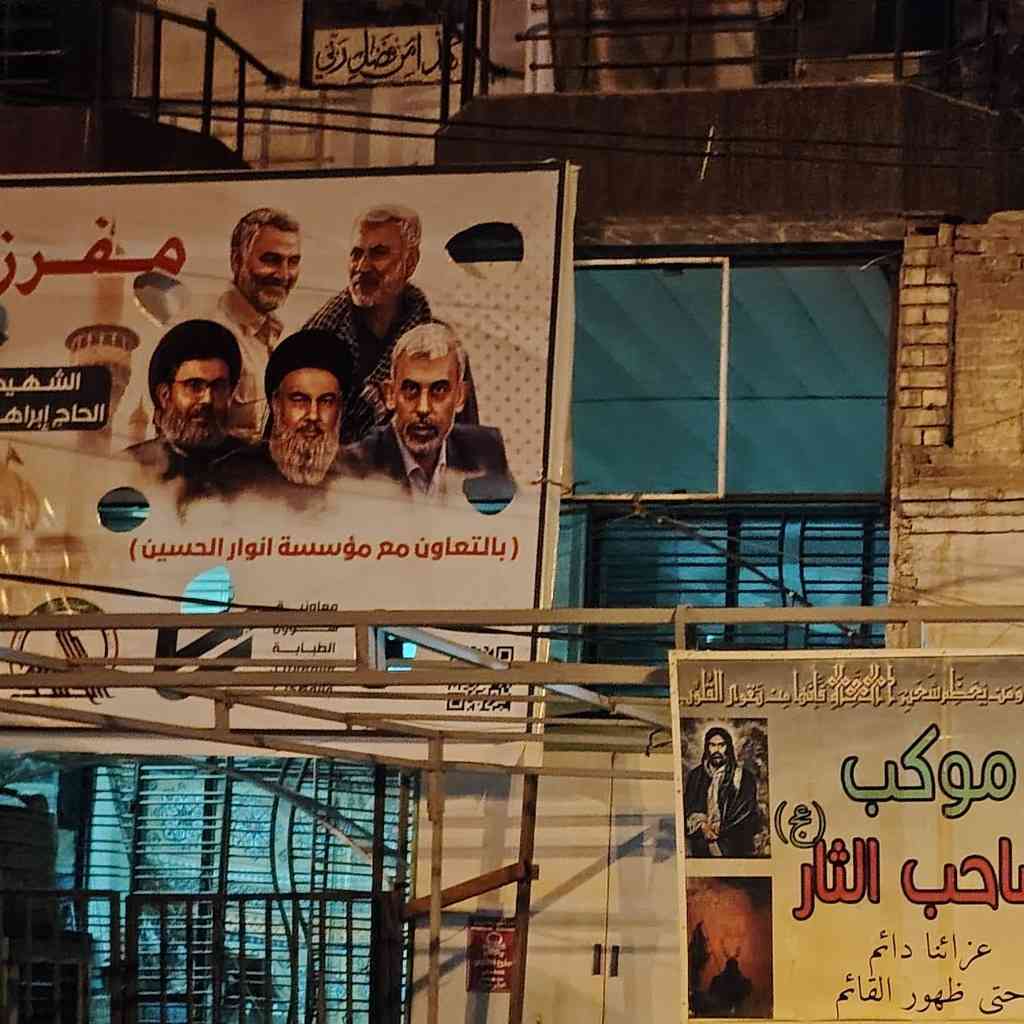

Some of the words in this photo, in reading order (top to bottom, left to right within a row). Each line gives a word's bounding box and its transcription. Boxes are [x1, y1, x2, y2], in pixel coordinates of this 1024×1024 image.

[315, 33, 350, 80] ربي
[347, 28, 400, 81] فضل
[0, 404, 49, 431] إبراه
[52, 403, 105, 428] الحاج
[226, 536, 272, 561] انوار
[279, 536, 372, 561] مؤسسة
[378, 539, 409, 561] مع
[272, 641, 336, 656] الطبابة
[841, 723, 1017, 819] موكب
[792, 837, 880, 921] الثار
[869, 929, 912, 976] دائم
[926, 932, 992, 971] عزائنا
[834, 973, 892, 1020] القائم
[902, 976, 964, 1013] ظهور
